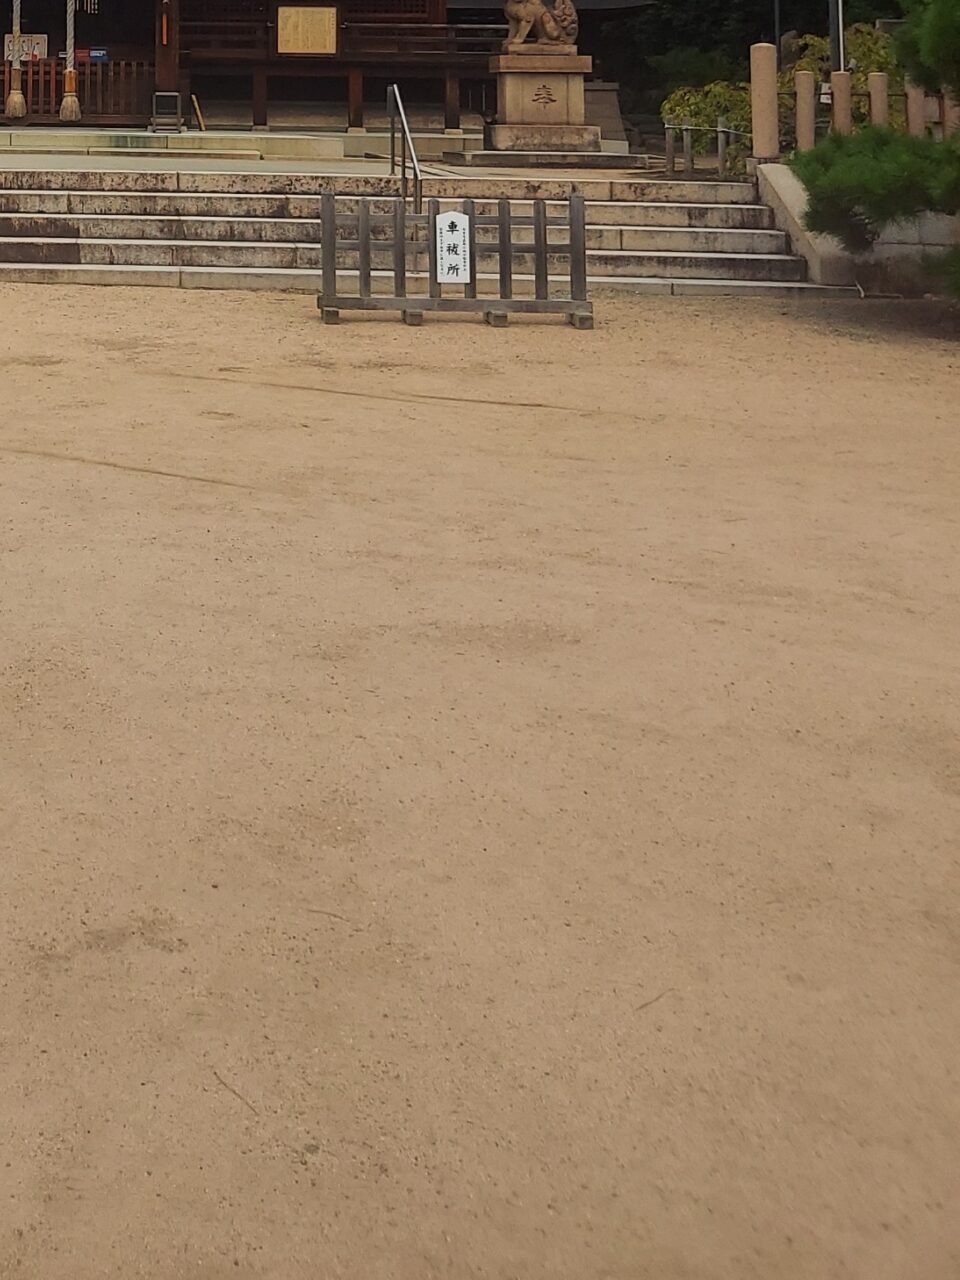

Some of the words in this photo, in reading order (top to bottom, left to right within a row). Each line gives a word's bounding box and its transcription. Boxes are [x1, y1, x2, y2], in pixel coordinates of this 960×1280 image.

[531, 84, 558, 110] 奉
[446, 220, 461, 277] 車祓所
